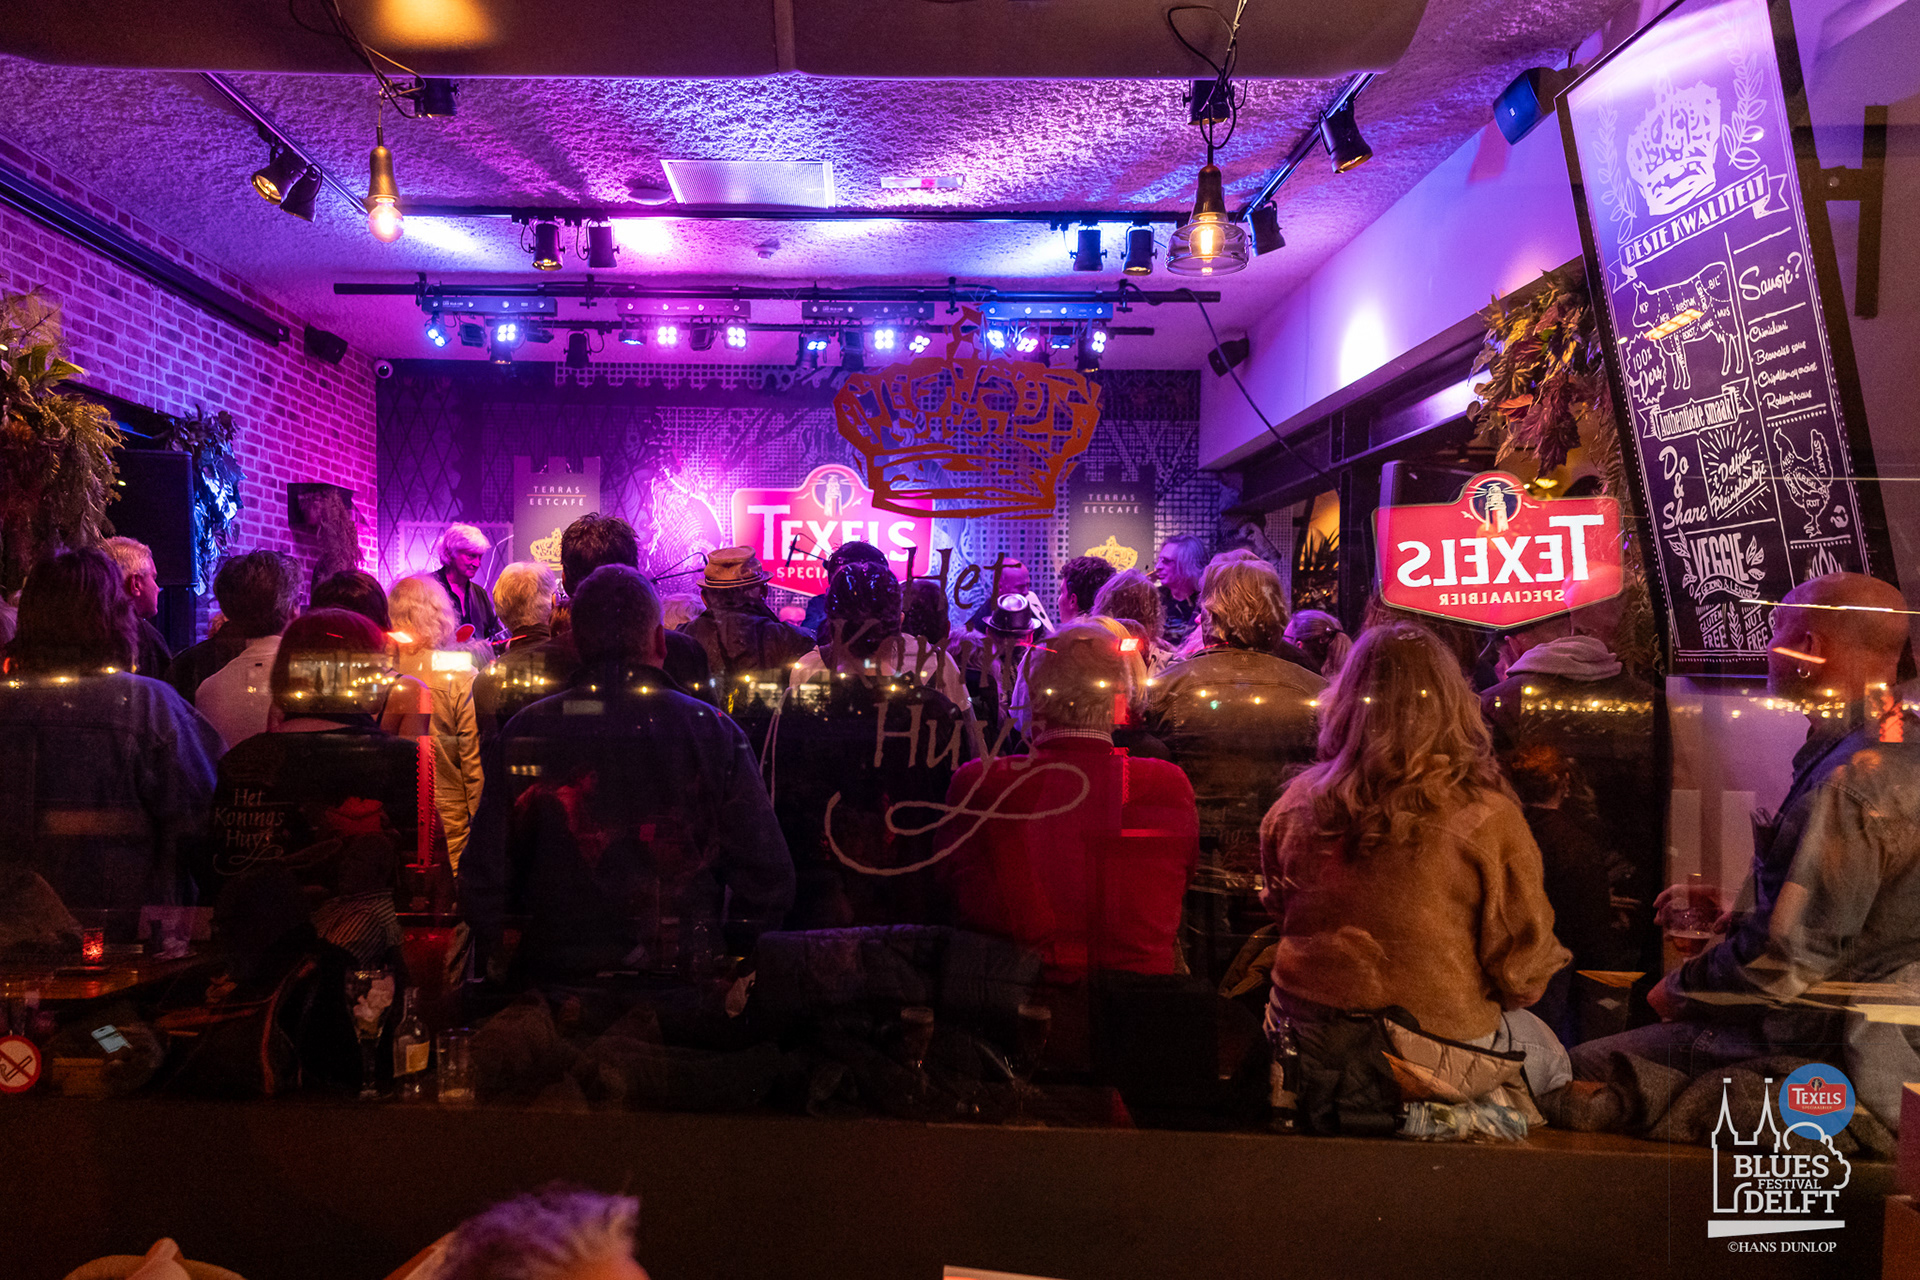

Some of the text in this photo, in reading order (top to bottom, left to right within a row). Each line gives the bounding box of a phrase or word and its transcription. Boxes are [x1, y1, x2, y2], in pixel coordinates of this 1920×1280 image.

[1624, 171, 1766, 265] BESTE KWALITEIT
[1703, 397, 1735, 426] smaak
[1659, 445, 1690, 481] Do
[533, 485, 581, 495] TERRAS
[1088, 493, 1136, 502] TERRAS
[1673, 472, 1685, 499] &
[529, 496, 585, 507] EETCAFÉ
[1084, 505, 1140, 514] EETCAFÉ
[1662, 498, 1708, 530] Share
[1690, 532, 1750, 581] VEGGIE
[902, 546, 1023, 611] Het
[1700, 609, 1723, 633] GLUTEN
[1744, 608, 1762, 631] NUT
[1702, 624, 1729, 649] FREE
[1746, 626, 1769, 651] FREE
[233, 788, 266, 807] Het
